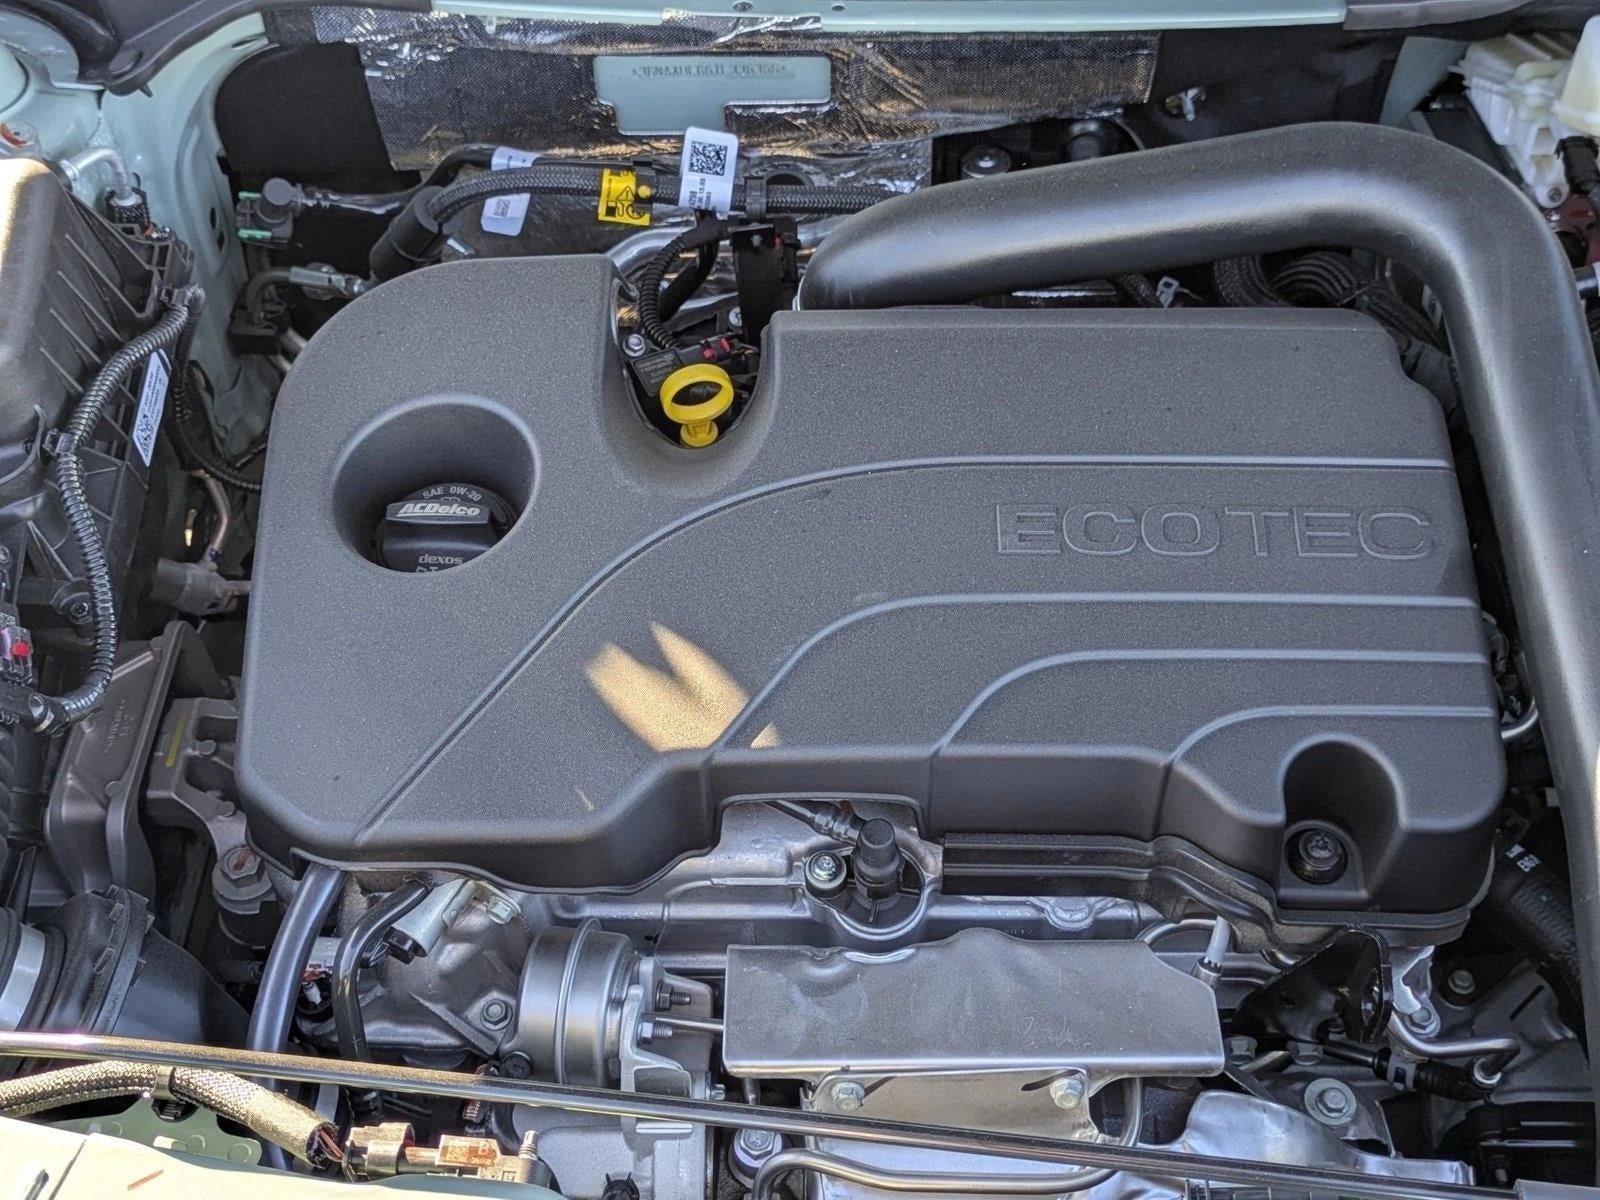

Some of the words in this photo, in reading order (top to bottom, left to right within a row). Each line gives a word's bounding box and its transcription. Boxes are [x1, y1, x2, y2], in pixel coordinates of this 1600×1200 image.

[422, 487, 444, 499] SAE
[449, 485, 482, 502] 0W-20
[398, 502, 481, 516] ACDelco
[996, 502, 1430, 560] ECOTEC
[418, 553, 464, 565] dexos
